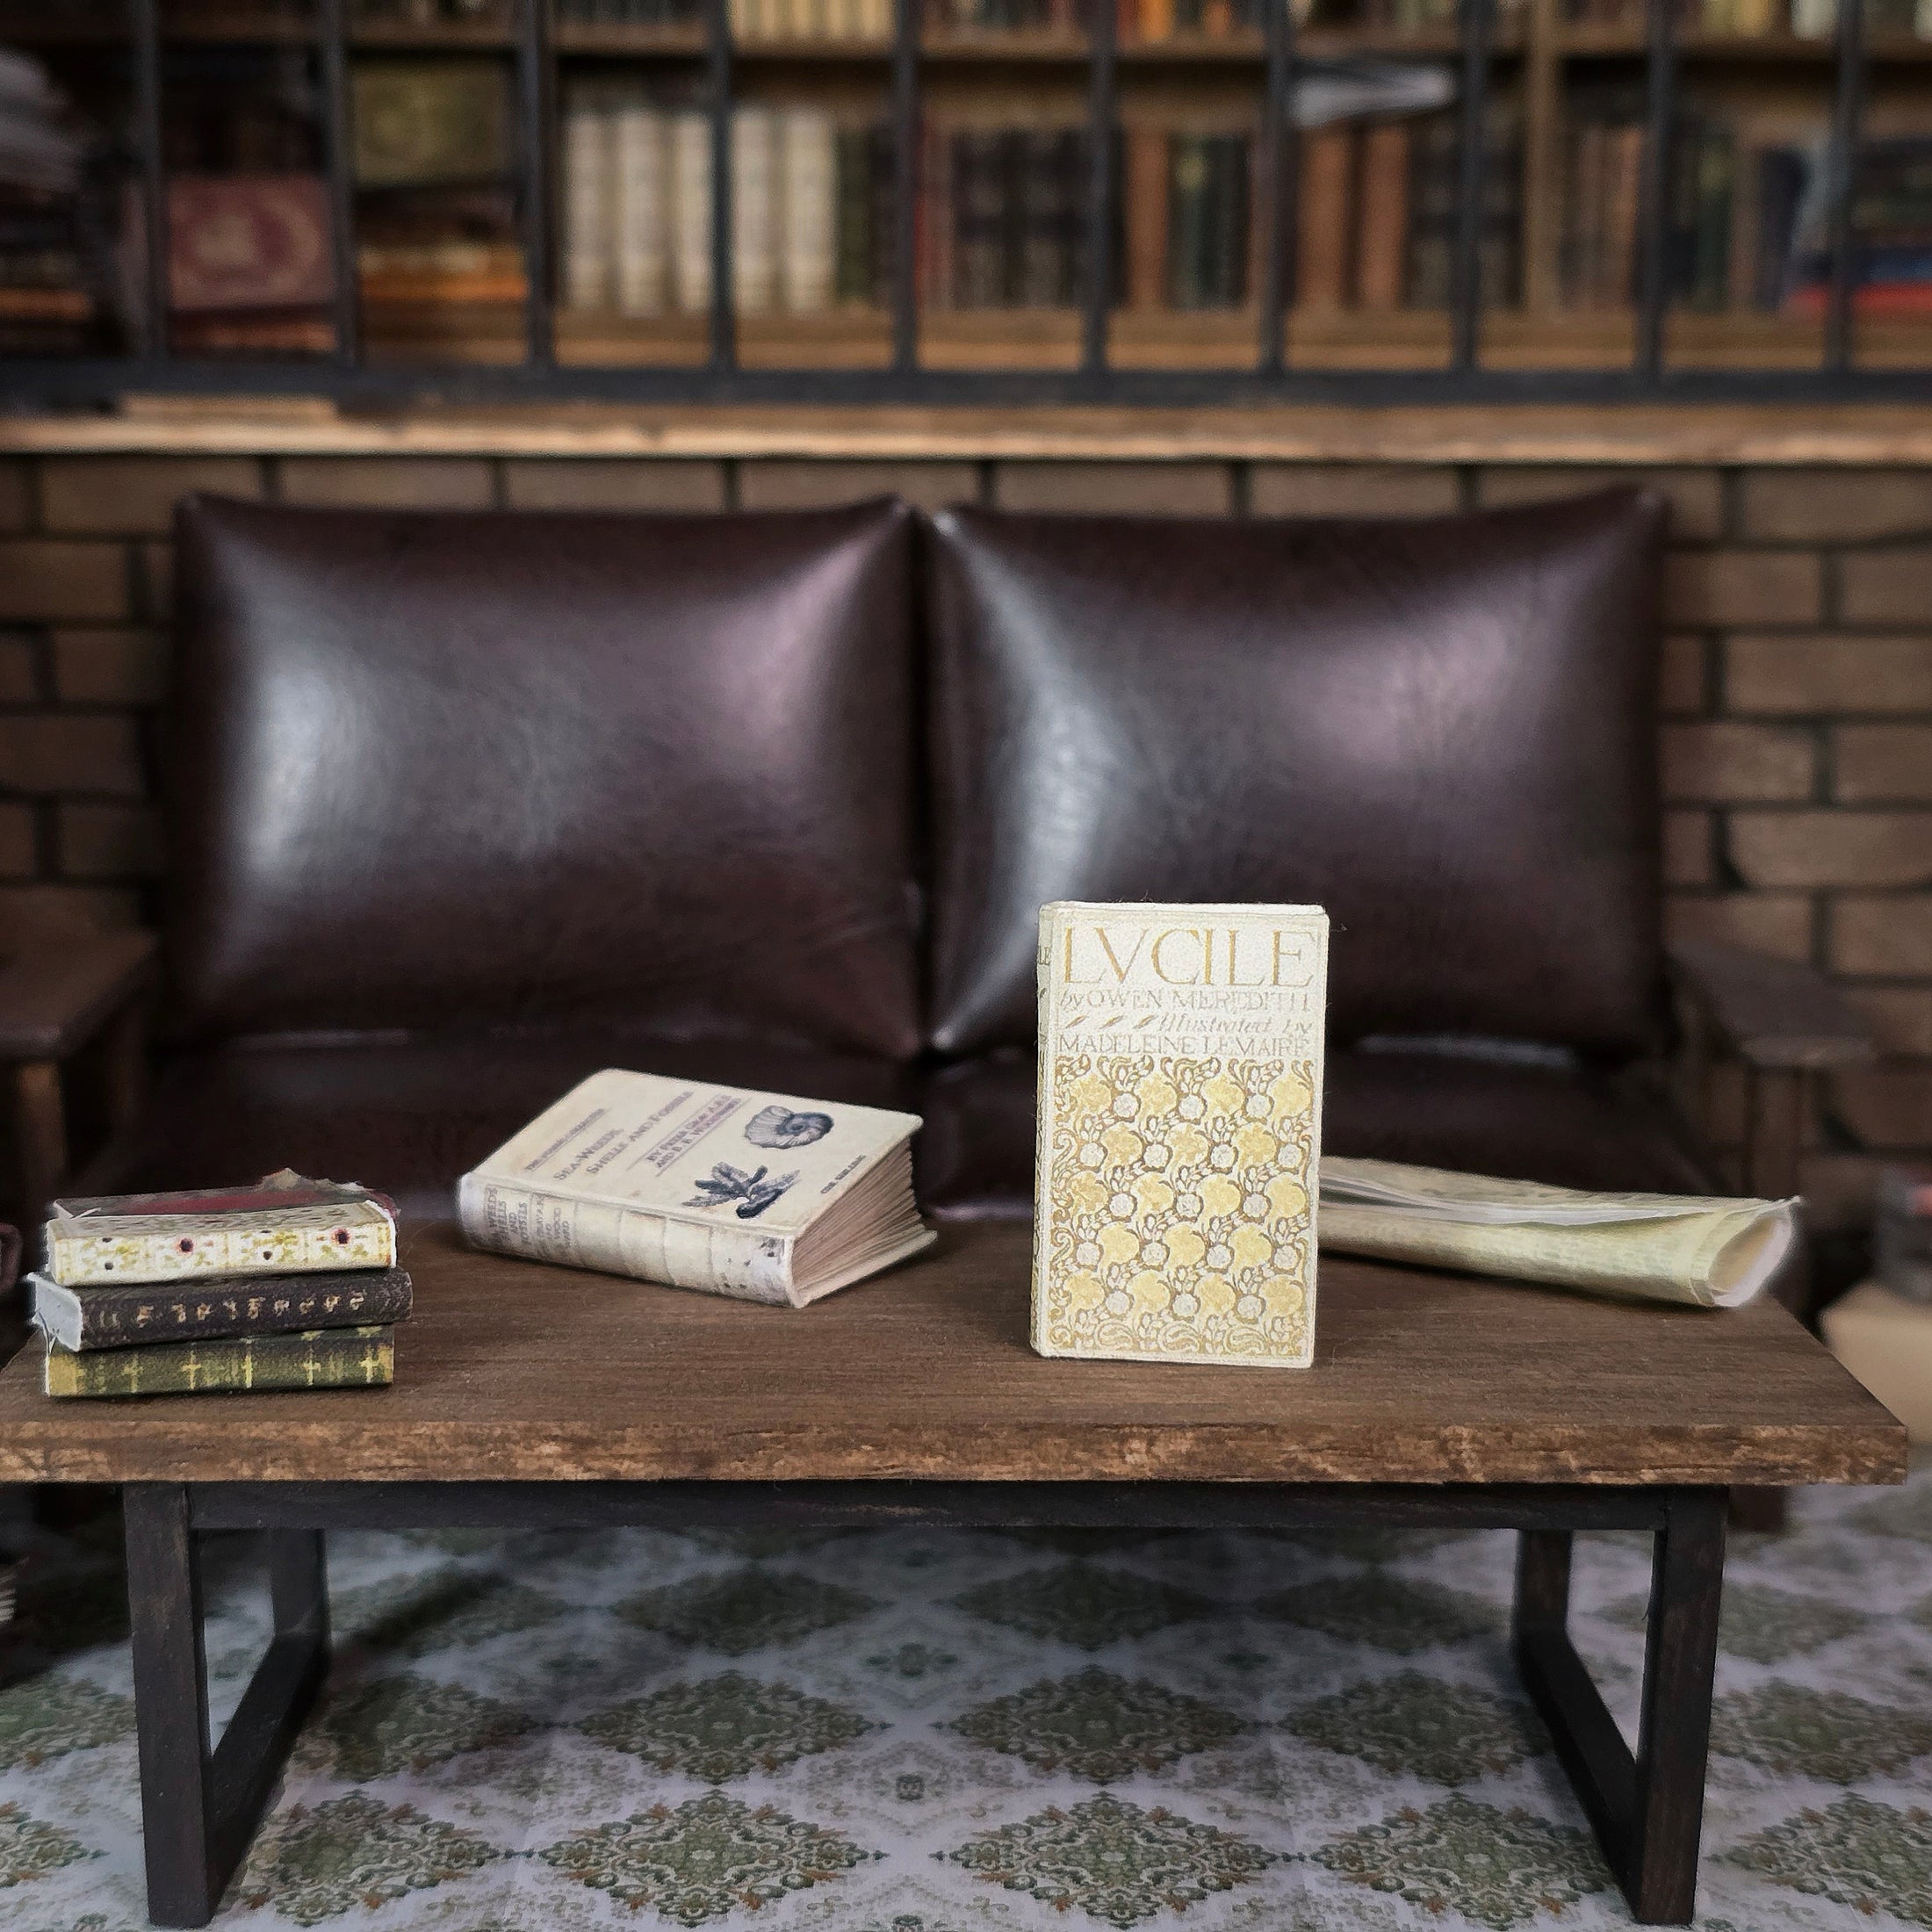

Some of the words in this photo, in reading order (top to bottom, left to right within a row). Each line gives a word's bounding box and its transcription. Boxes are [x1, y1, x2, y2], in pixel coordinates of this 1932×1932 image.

[1063, 927, 1315, 986] LVCILE
[1087, 990, 1163, 1010] OWEN
[1058, 1034, 1196, 1054] MADELEINE
